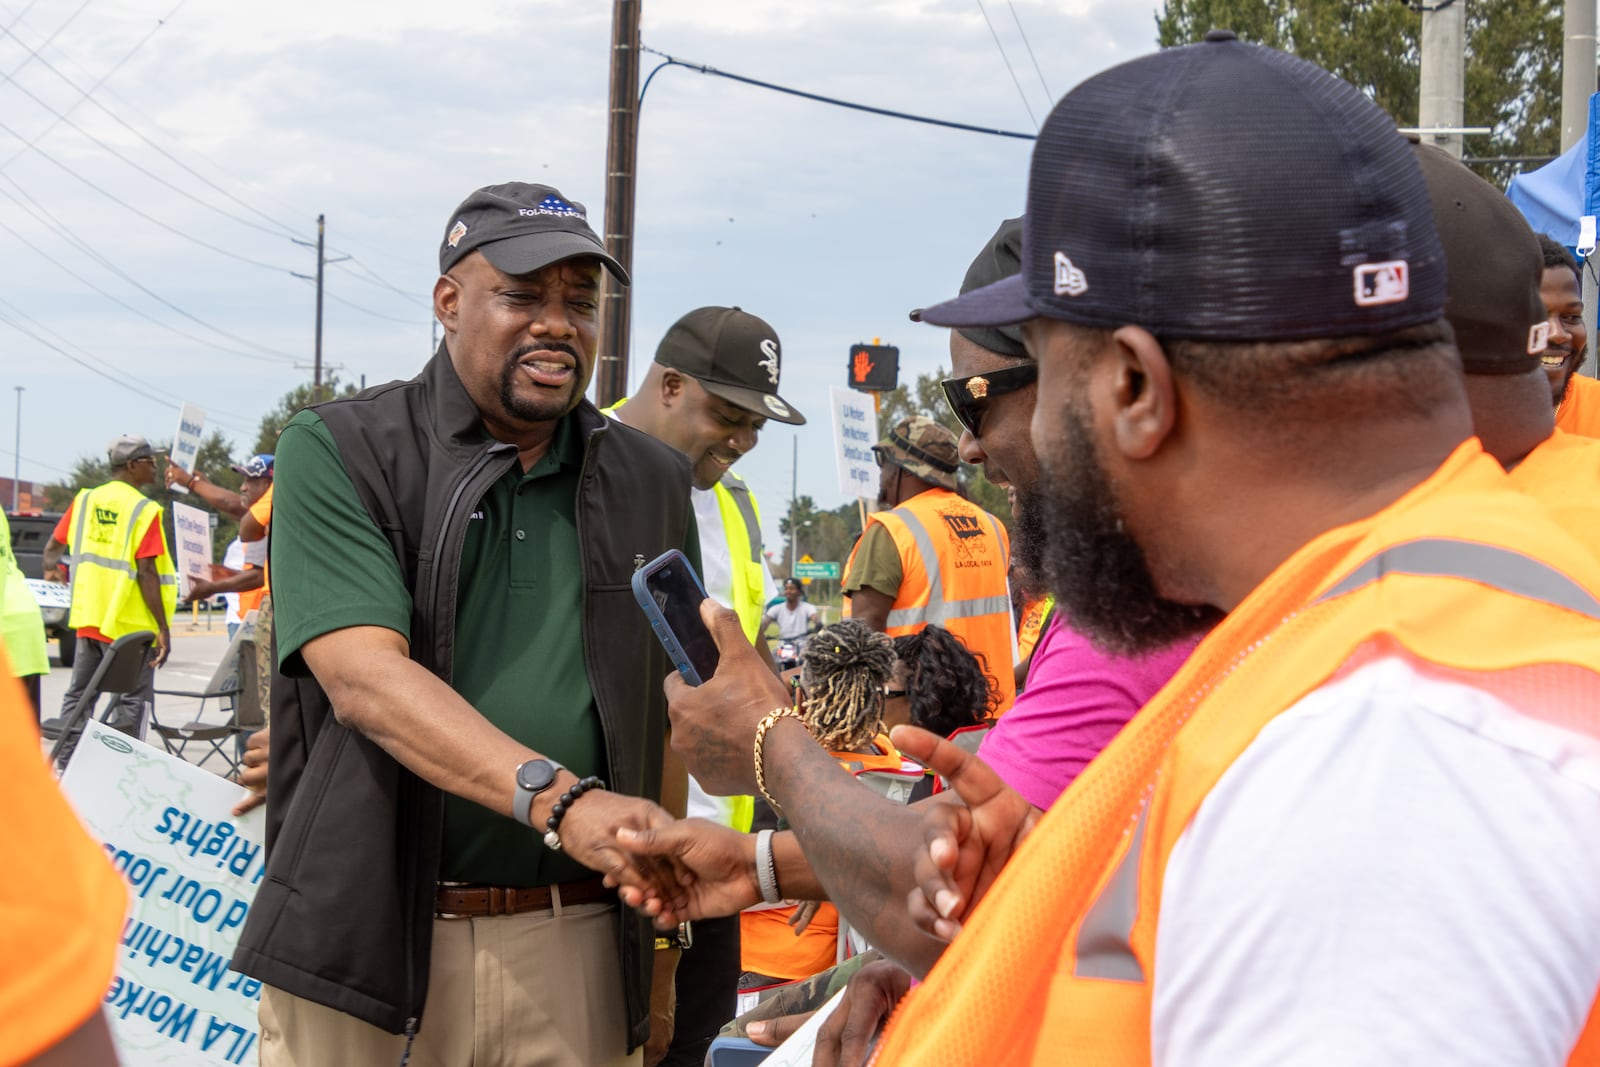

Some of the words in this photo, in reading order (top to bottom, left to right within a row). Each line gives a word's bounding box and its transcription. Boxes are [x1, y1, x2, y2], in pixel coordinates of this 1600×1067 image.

[154, 806, 261, 878] Rights
[162, 875, 222, 923] Our
[119, 917, 232, 991] Machin
[103, 975, 199, 1043] Worke
[200, 1015, 257, 1065] ILA
